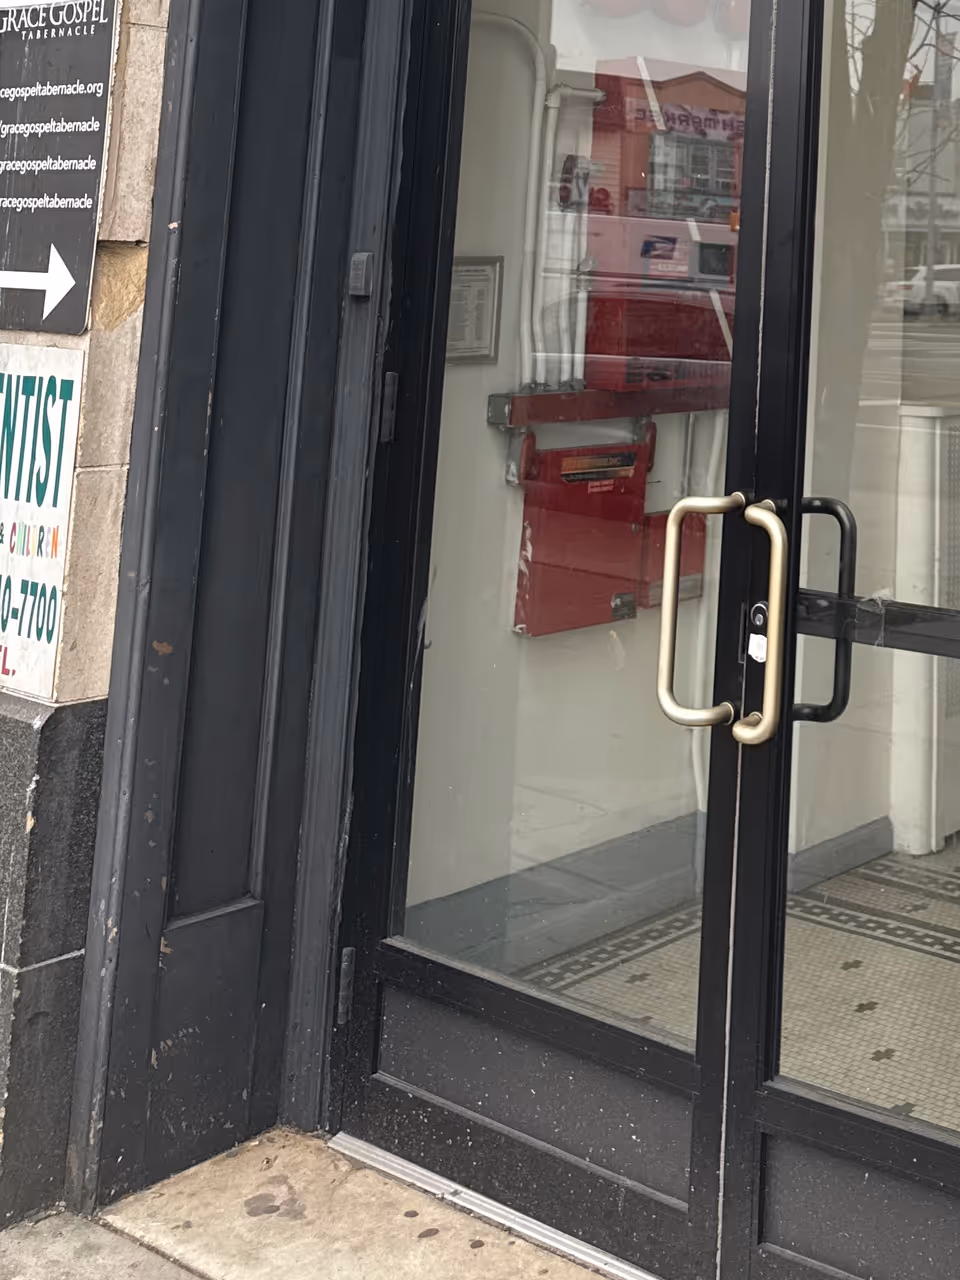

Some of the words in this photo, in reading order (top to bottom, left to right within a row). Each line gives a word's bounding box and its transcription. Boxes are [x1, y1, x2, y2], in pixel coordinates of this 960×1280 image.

[21, 24, 96, 40] TABERNACLE
[0, 372, 74, 508] NTIST
[9, 521, 59, 559] CHILDREN
[0, 574, 58, 645] 0-7700
